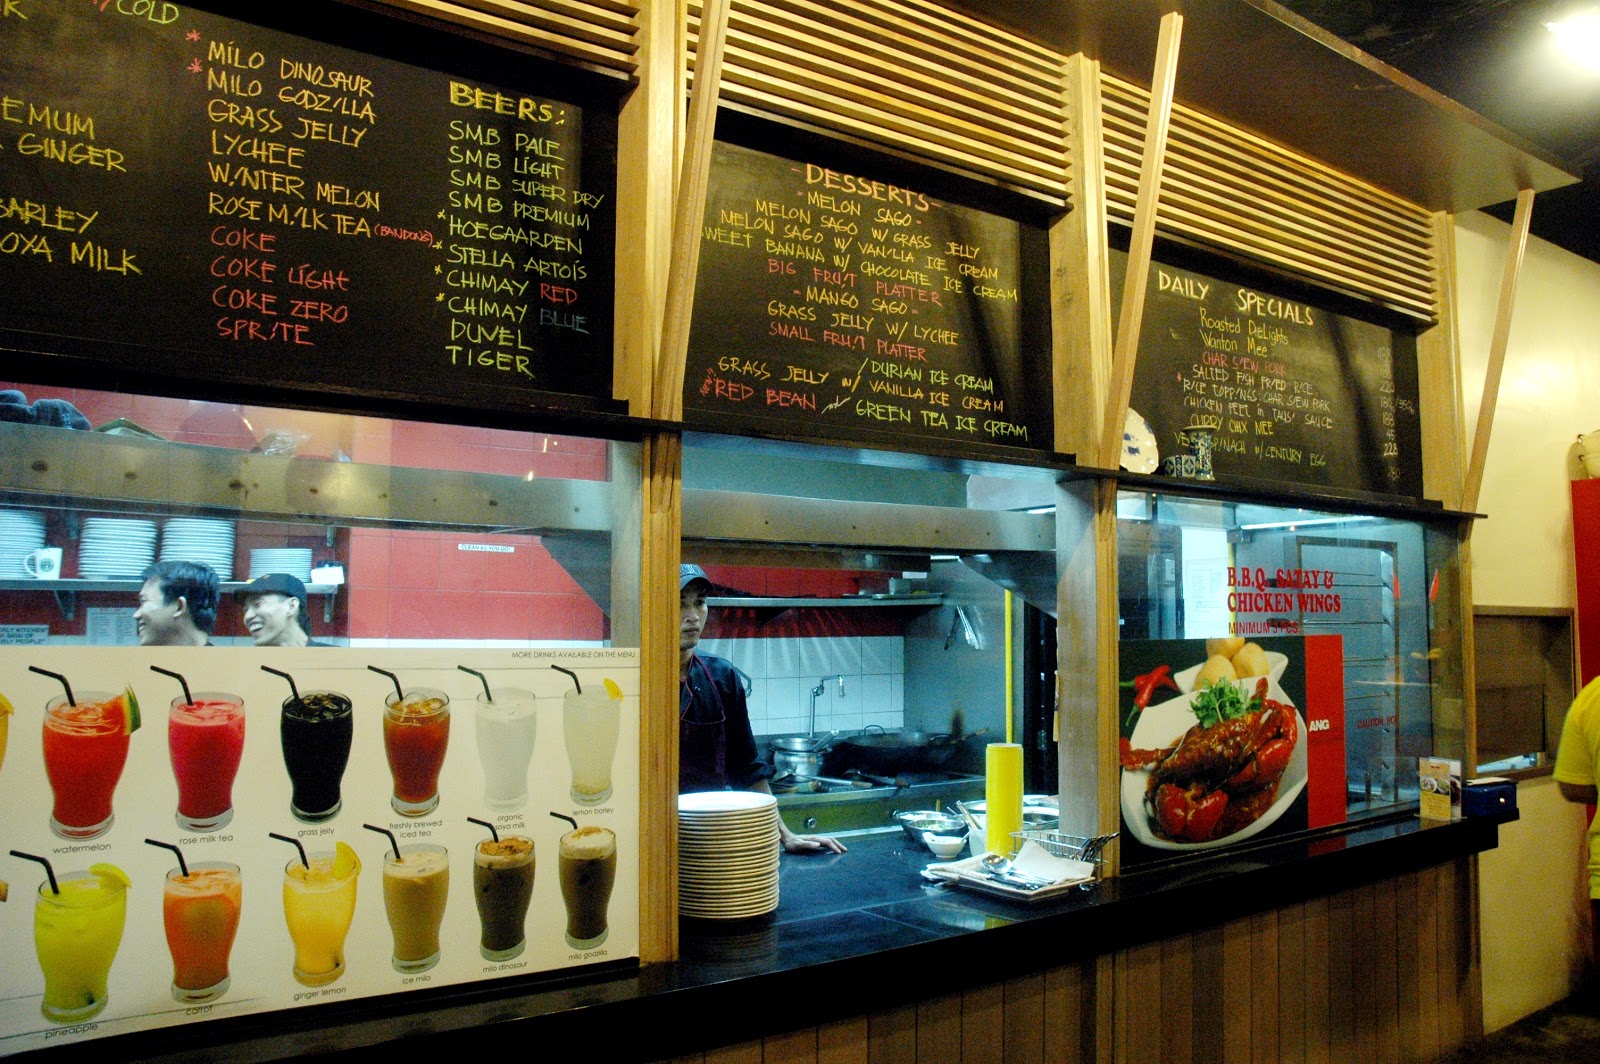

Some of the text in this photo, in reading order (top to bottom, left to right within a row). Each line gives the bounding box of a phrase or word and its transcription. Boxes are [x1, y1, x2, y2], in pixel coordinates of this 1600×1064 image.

[208, 41, 374, 97] MILO DINOSAUR
[208, 68, 377, 124] MILO GODZILLA
[208, 99, 367, 148] GRASS JELLY
[18, 133, 126, 172] GINGER
[212, 129, 305, 168] LYCHEE
[448, 121, 565, 161] SMB PALE
[448, 146, 565, 180] SMB LIGHT
[208, 162, 380, 212] WINTER MELON
[450, 169, 604, 209] SMB SUPER DRY
[806, 163, 929, 212] DESSERTS
[209, 192, 371, 238] ROSE MILK TEA
[449, 191, 589, 231] SMB PREMIUM
[808, 191, 911, 227] MELON SAGO
[211, 226, 276, 252] COKE
[450, 215, 582, 255] HOEGAARDEN
[722, 209, 774, 234] MELON
[783, 224, 823, 243] SAGO
[858, 242, 915, 263] VANILLA
[925, 256, 947, 271] ICE
[959, 263, 998, 280] CREAM
[756, 199, 810, 224] MELON
[821, 215, 858, 235] SAGO
[893, 233, 931, 249] GRASS
[945, 242, 980, 259] JELLY
[71, 241, 142, 275] MILK
[210, 256, 277, 282] COKE
[447, 244, 587, 281] STELLA ARTOIS
[765, 238, 825, 263] BANANA
[861, 261, 931, 286] CHOCOLATE
[943, 276, 962, 294] ICE
[973, 286, 1018, 303] CREAM
[447, 270, 577, 304] CHIMAY RED
[768, 259, 944, 308] BIG FRUIT PLATTER
[807, 285, 907, 315] MANGO SAGO
[1159, 269, 1314, 325] DAILY SPECIALS
[212, 285, 348, 323] COKE ZERO
[448, 297, 590, 335] CHIMAY BLUE
[1200, 307, 1240, 334] Roasted
[217, 317, 314, 346] SPRITE
[451, 318, 533, 351] DUVEL
[768, 300, 817, 321] GRASS
[831, 312, 874, 332] JELLY
[914, 325, 959, 346] LYCHEE
[769, 321, 928, 362] SMALL FRUIT PLATTER
[445, 346, 535, 379] TIGER
[871, 360, 993, 395] DURIAN ICE CREAM
[718, 356, 1003, 413] GRASS JELLY VANILLA ICE CREAM
[715, 378, 754, 401] RED
[766, 388, 816, 411] BEAN
[856, 399, 911, 423] GREEN
[921, 410, 948, 429] TEA
[955, 415, 977, 434] ICE
[984, 419, 1028, 441] CREAM
[1227, 566, 1270, 592] B.B.Q.
[1277, 568, 1320, 589] SATAY
[1324, 570, 1334, 589] &
[1227, 592, 1342, 613] CHICKEN WINGS
[1228, 622, 1272, 634] MINIMUM
[1309, 719, 1329, 732] ANG
[389, 819, 442, 831] freshly brewed
[494, 821, 526, 832] soya milk
[497, 813, 523, 822] organic
[594, 807, 614, 816] barley
[53, 842, 112, 854] watermelon
[179, 834, 233, 845] rose milk tea
[298, 826, 335, 838] grass jelly
[400, 829, 417, 838] iced
[482, 961, 527, 973] milo dinosaur
[568, 952, 582, 961] milo
[293, 987, 346, 1001] ginger lemon
[402, 974, 431, 984] ice milo
[186, 1005, 213, 1016] carrot
[44, 1022, 98, 1040] pineapple
